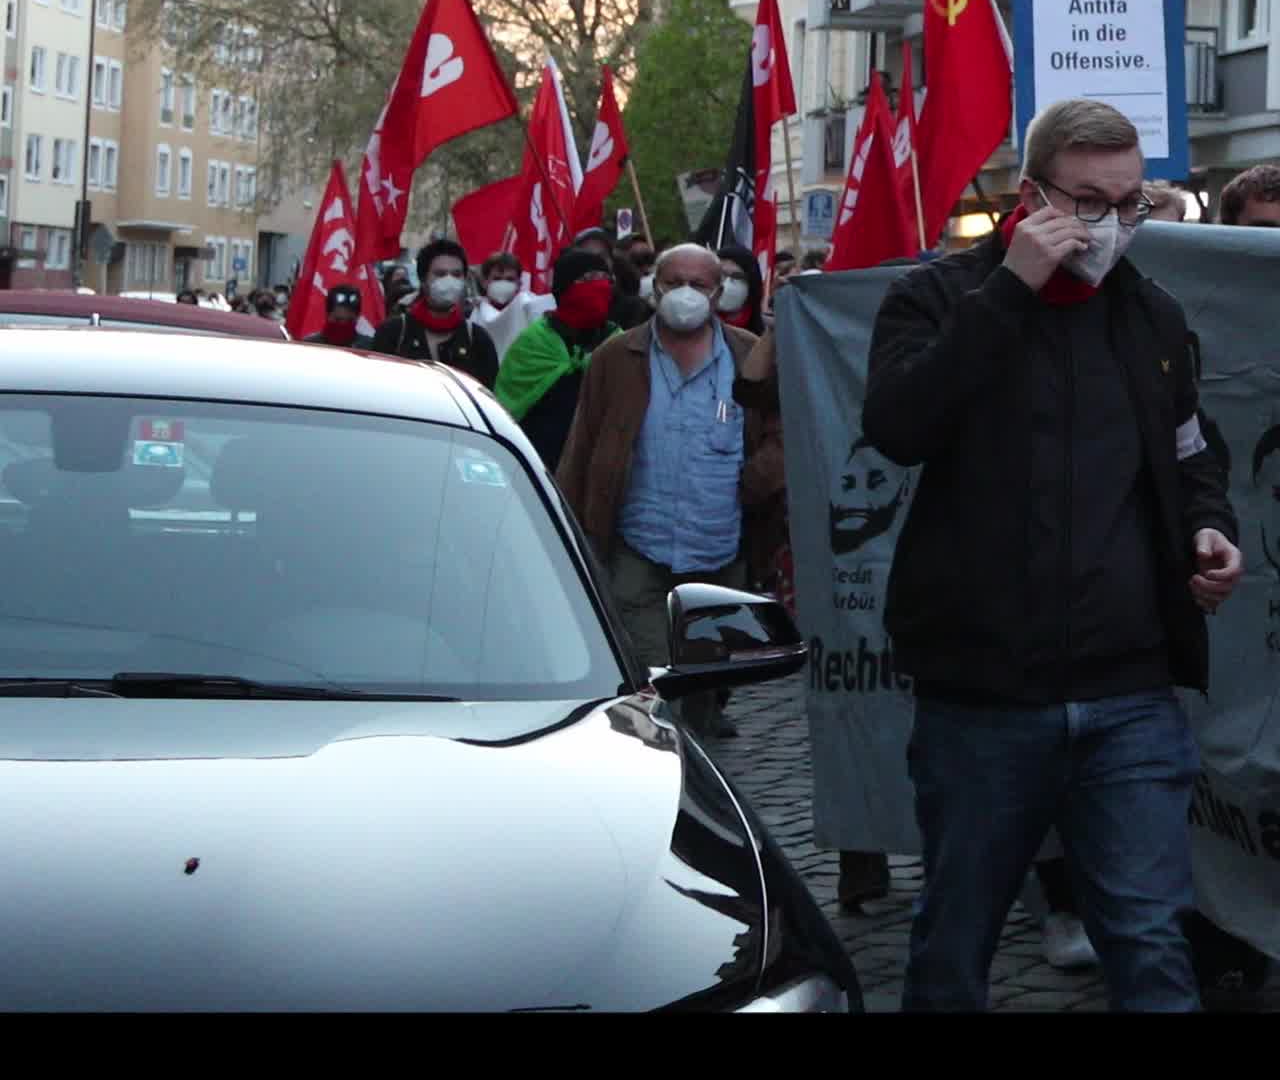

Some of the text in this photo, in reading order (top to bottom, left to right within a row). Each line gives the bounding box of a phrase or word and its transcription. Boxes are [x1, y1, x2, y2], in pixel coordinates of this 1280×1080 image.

[1072, 23, 1127, 42] in die
[1050, 51, 1151, 70] Offensive.
